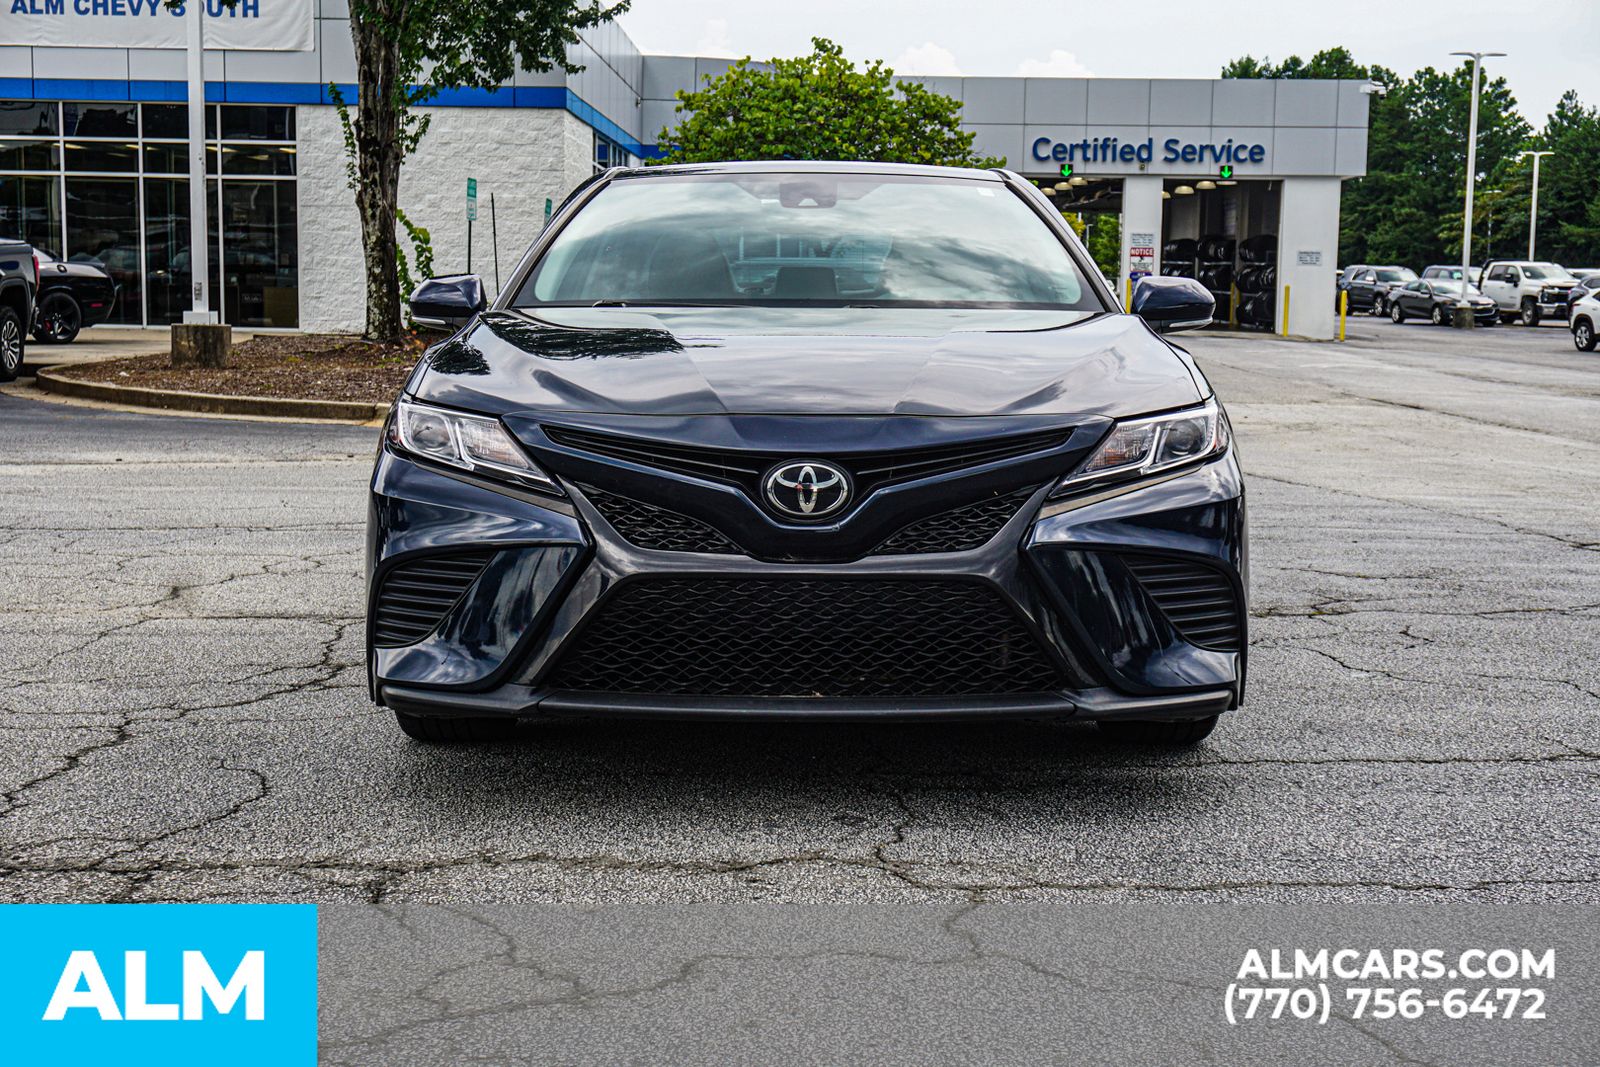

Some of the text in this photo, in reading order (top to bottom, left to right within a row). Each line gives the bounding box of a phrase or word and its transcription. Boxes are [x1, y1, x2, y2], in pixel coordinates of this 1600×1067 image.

[11, 0, 65, 15] ALM
[74, 0, 161, 16] CHEVY
[1032, 137, 1265, 163] Certified Service
[1131, 248, 1153, 256] NOTICE
